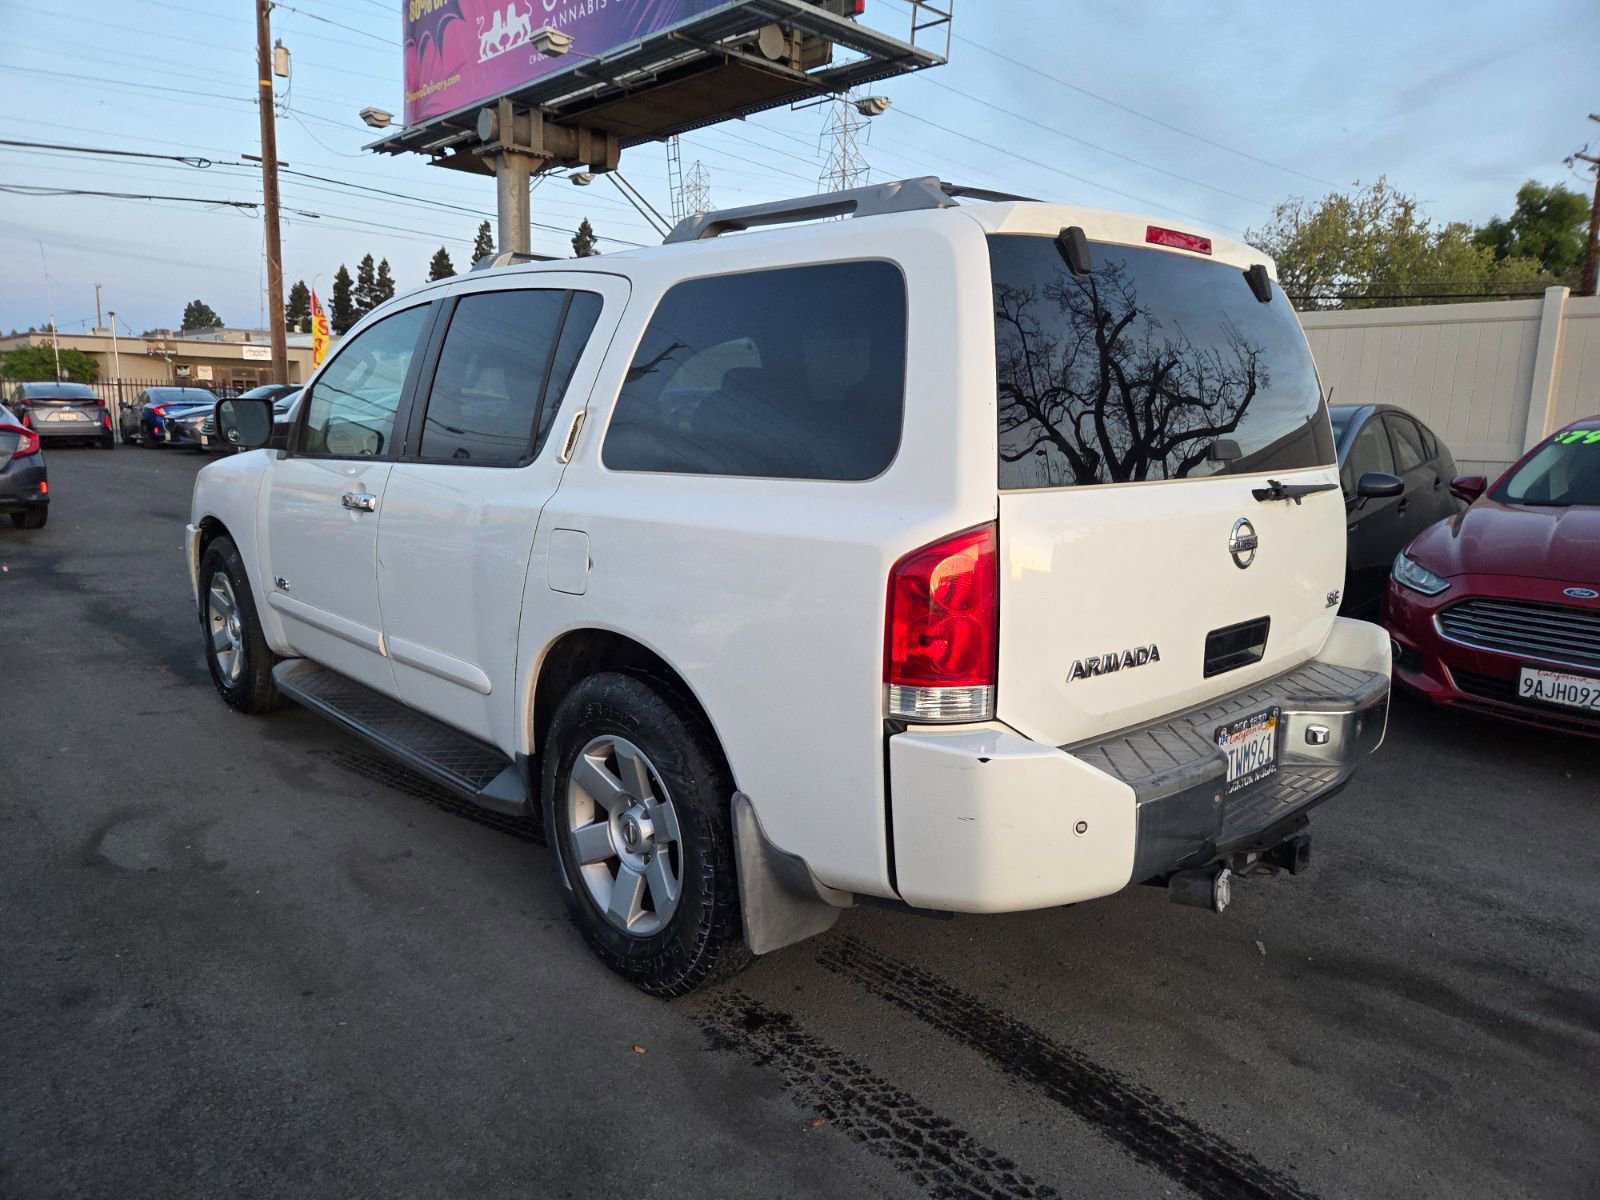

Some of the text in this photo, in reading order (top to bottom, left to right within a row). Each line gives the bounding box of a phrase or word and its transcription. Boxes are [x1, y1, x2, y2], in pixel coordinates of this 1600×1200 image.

[543, 0, 607, 28] CANNABIS
[1065, 643, 1161, 683] ARMADA
[1523, 677, 1600, 707] 9AJH092
[1228, 733, 1273, 781] TWM961
